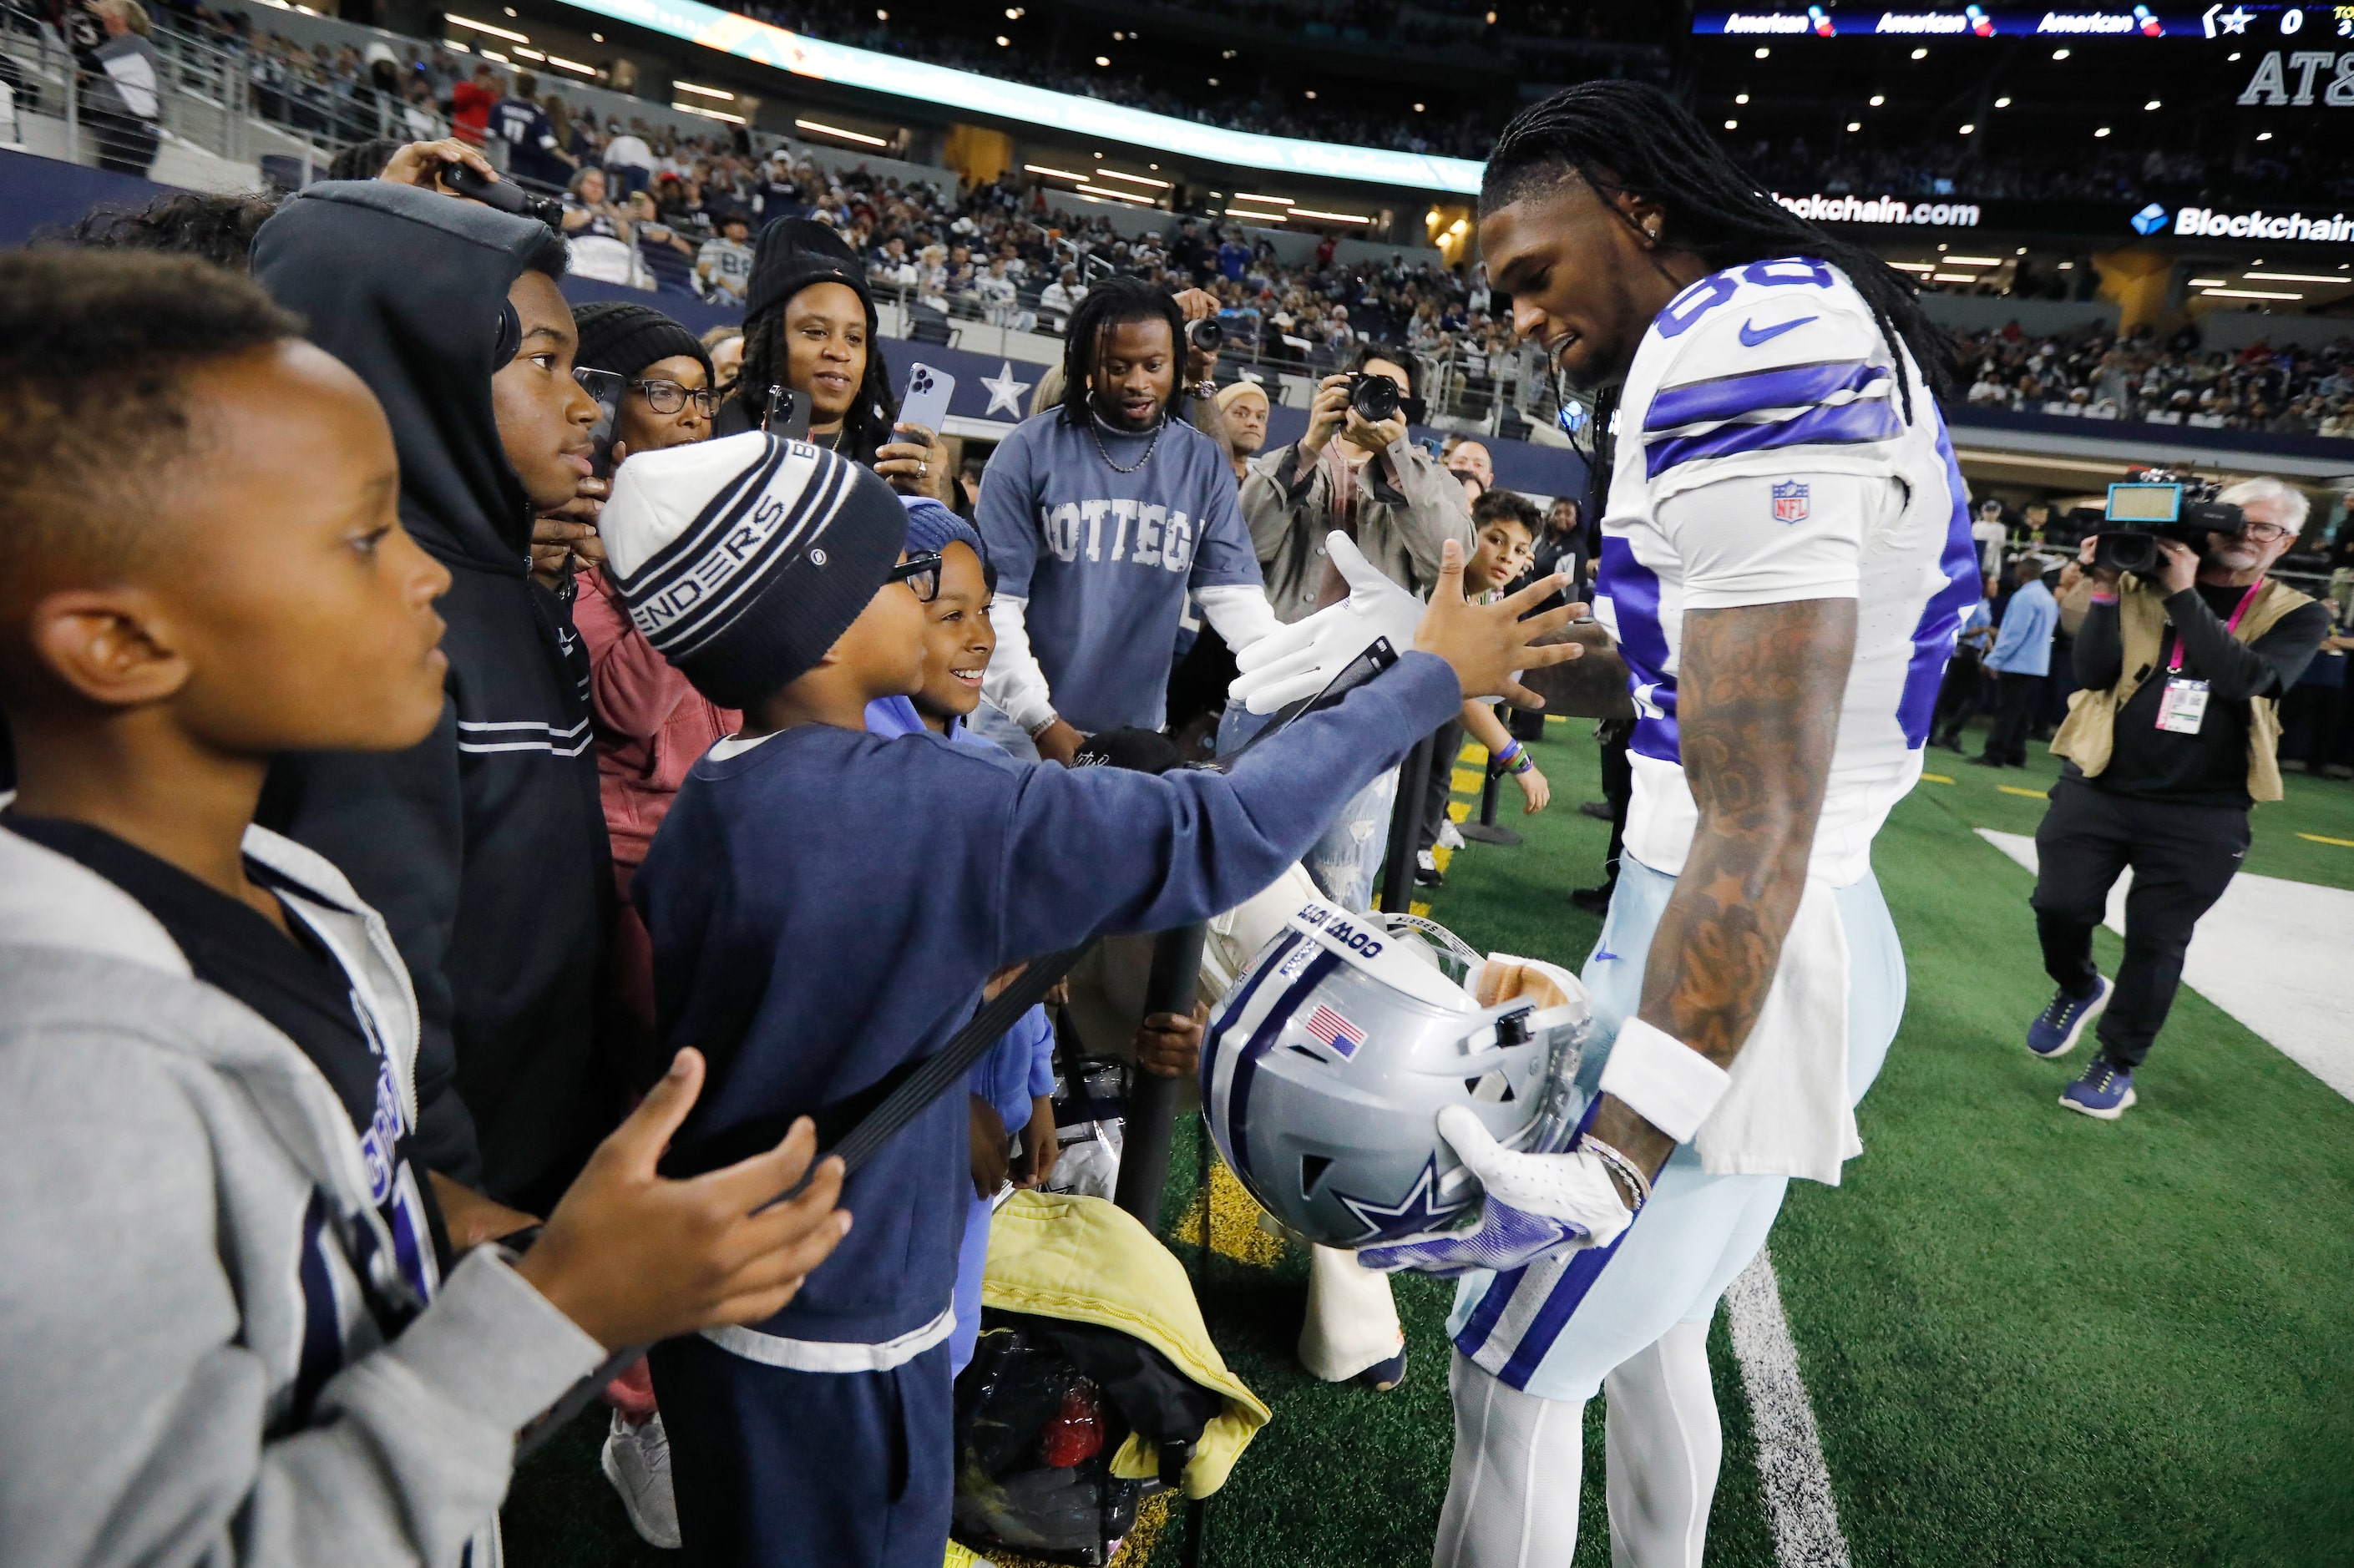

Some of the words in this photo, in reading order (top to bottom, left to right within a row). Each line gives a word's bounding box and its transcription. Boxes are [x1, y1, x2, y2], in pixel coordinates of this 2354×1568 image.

[1724, 13, 1810, 34] American
[1876, 12, 1967, 33] American
[2037, 12, 2134, 34] American
[2281, 9, 2304, 34] 0
[2333, 6, 2354, 20] TO
[1776, 498, 1808, 519] NFL
[1041, 498, 1206, 574] OTTEG
